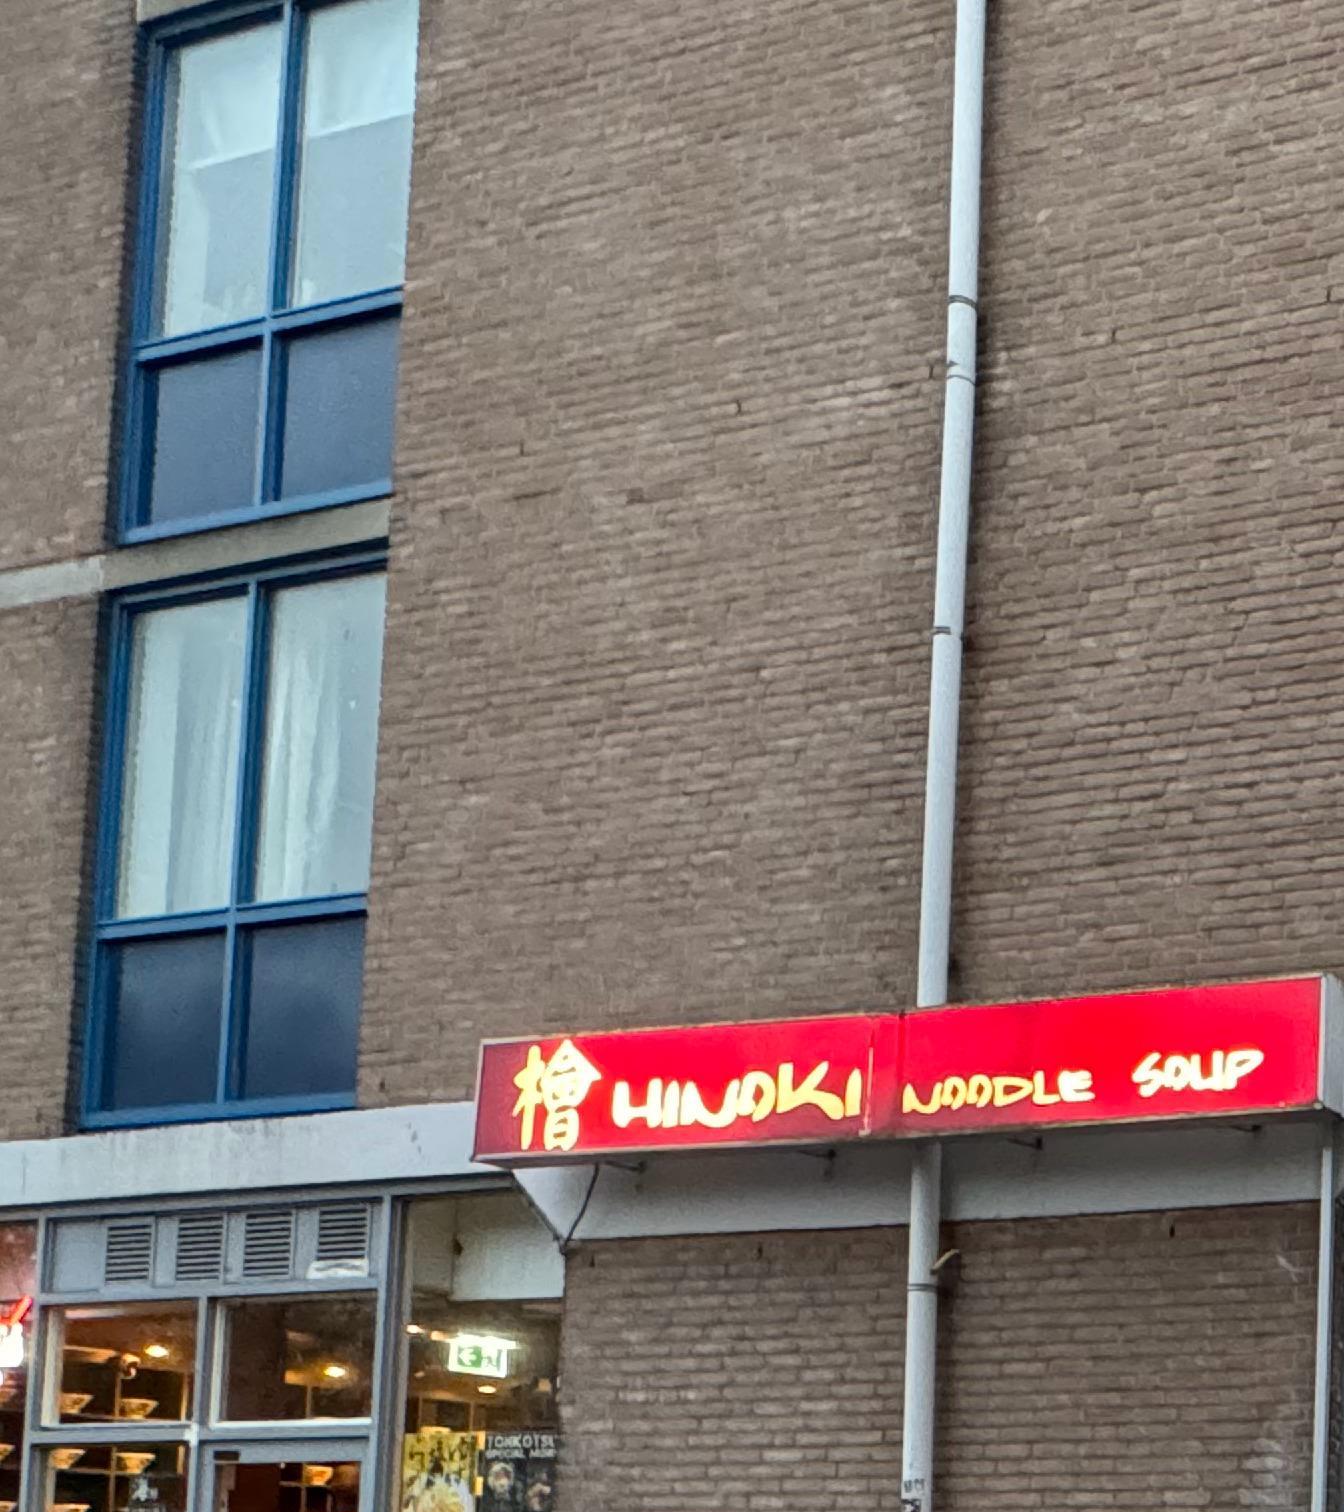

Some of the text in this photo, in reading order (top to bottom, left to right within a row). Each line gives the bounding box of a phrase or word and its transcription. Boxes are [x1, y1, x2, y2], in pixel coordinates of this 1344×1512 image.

[513, 1039, 602, 1151] 檜
[611, 1060, 862, 1129] HINOKI
[901, 1048, 1265, 1114] NOODLE SOUP
